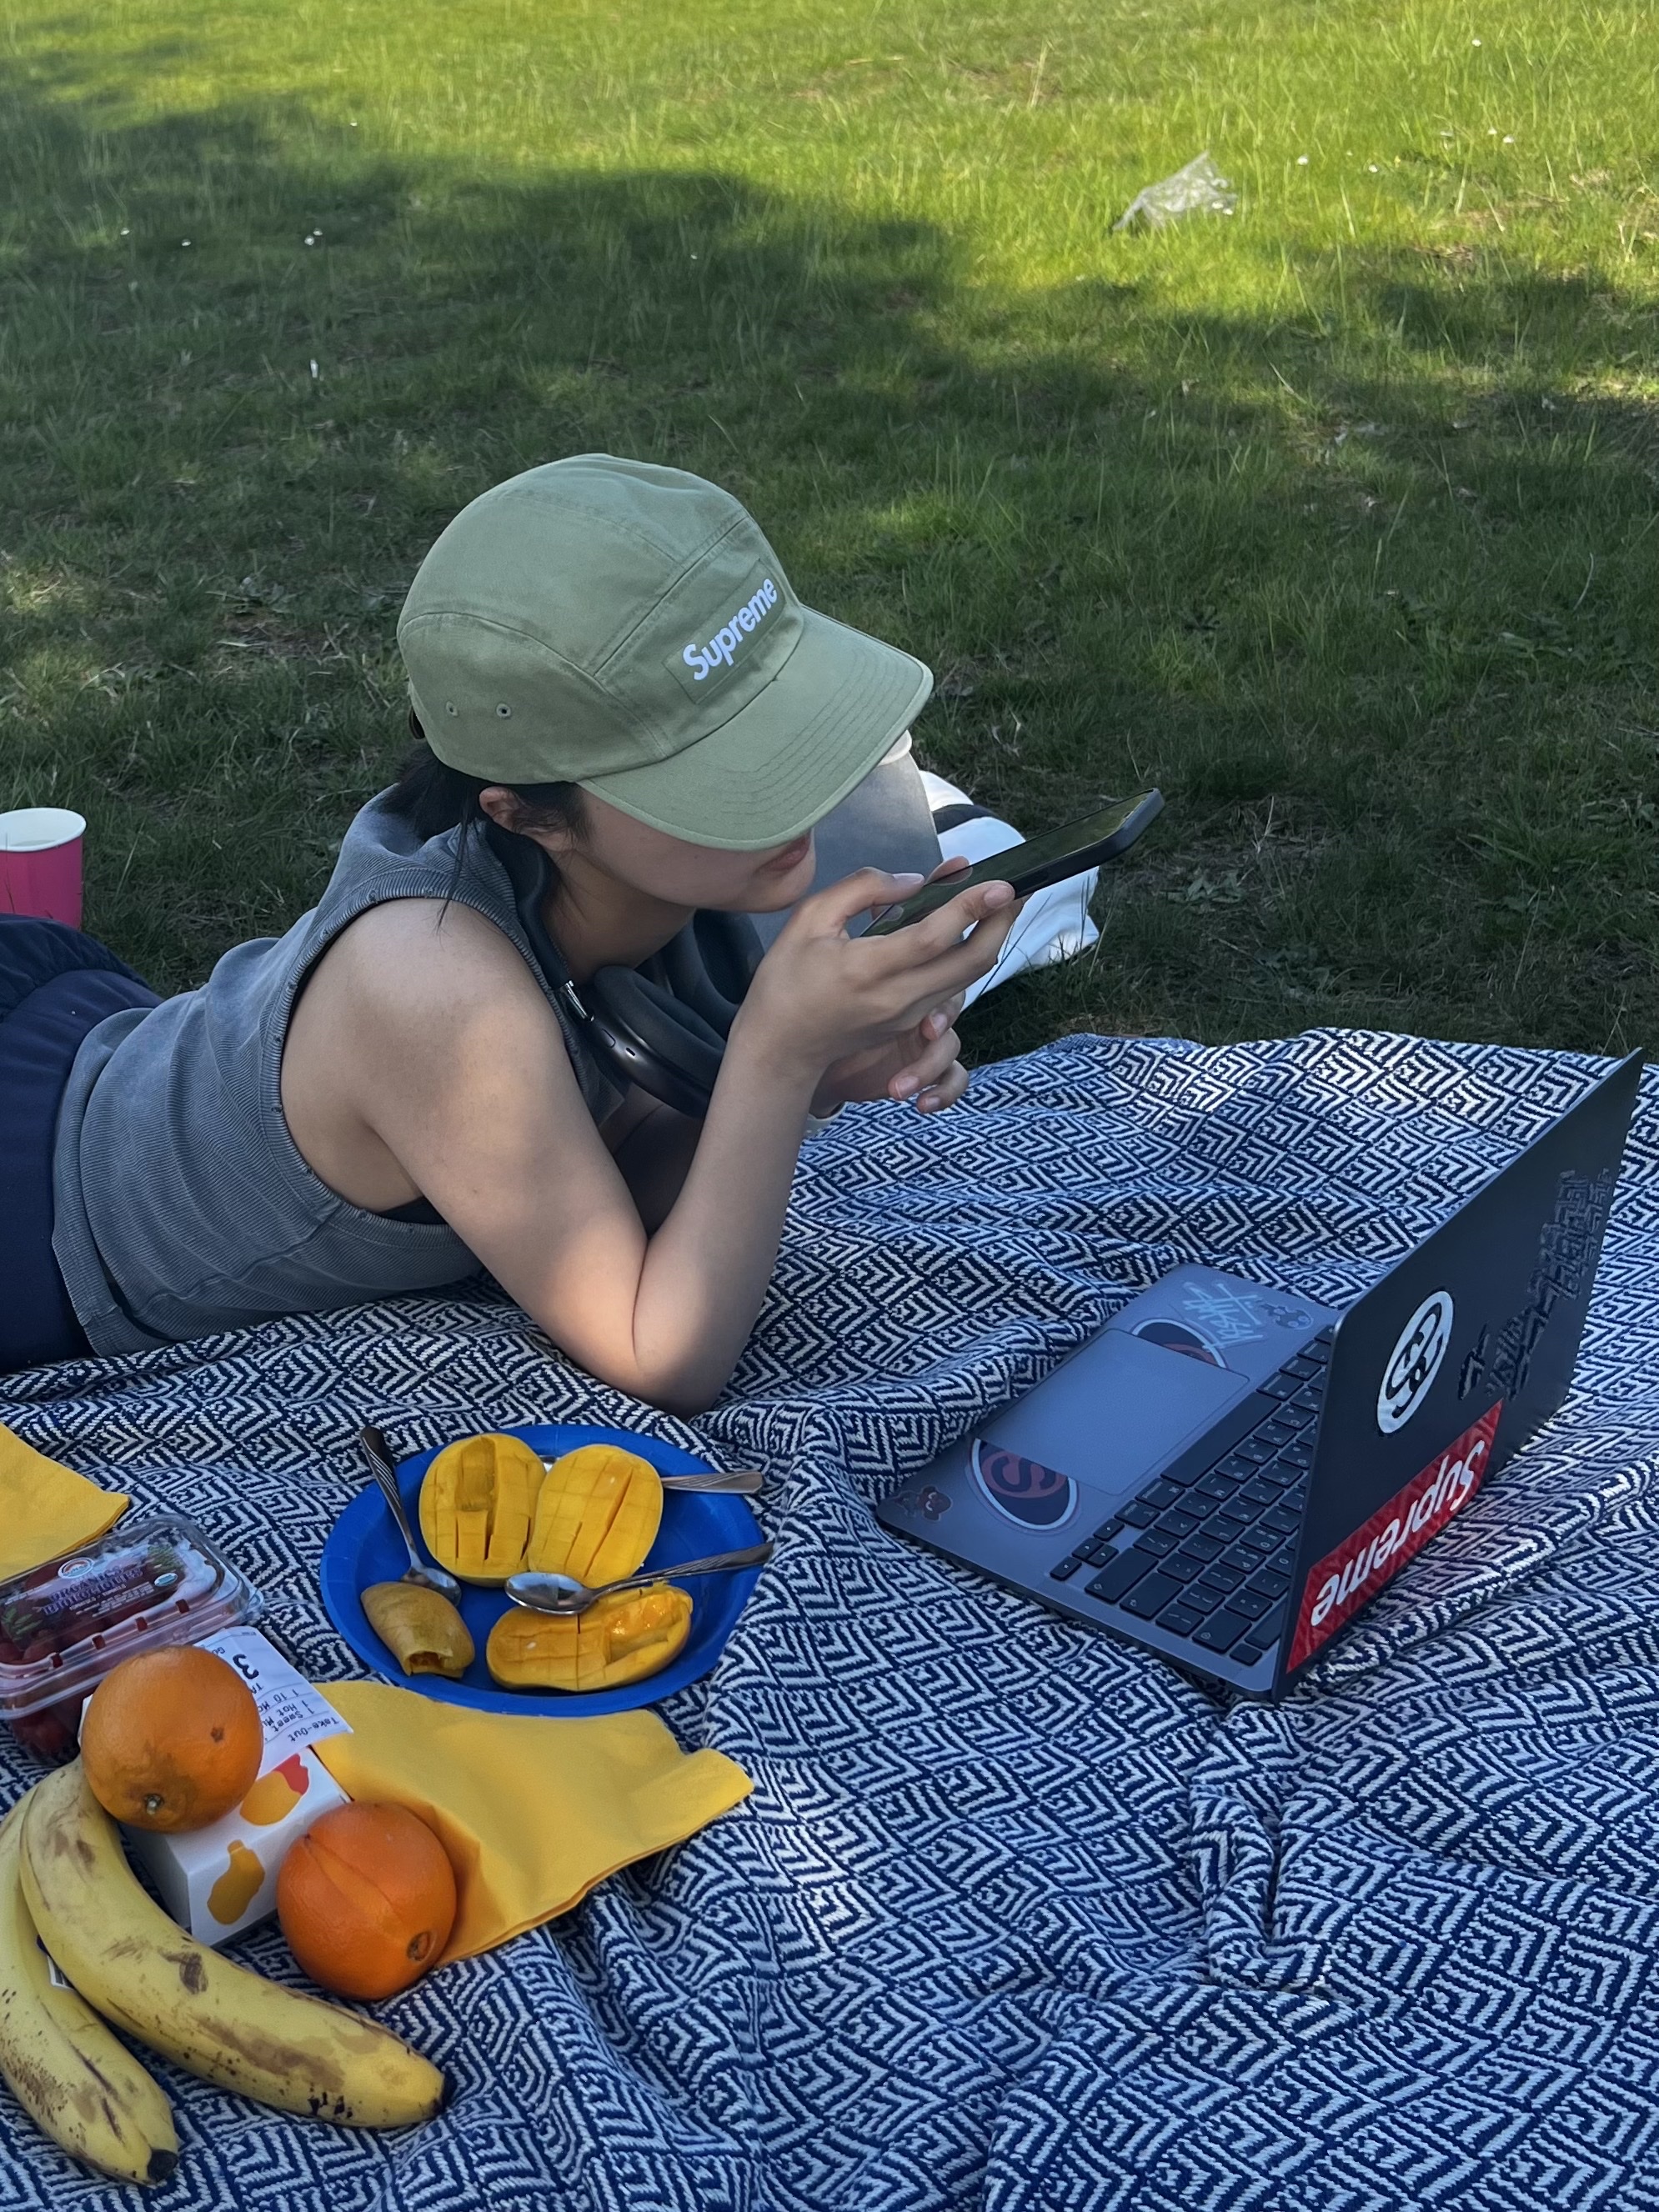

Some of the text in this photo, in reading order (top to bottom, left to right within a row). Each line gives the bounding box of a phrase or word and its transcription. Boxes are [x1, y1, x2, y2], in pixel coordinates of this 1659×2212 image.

[683, 578, 778, 681] Supreme
[1311, 1439, 1485, 1628] Supreme
[233, 1654, 260, 1679] 3
[273, 1692, 288, 1703] 10
[273, 1710, 303, 1733] Sweet
[288, 1716, 339, 1742] Take-Out
